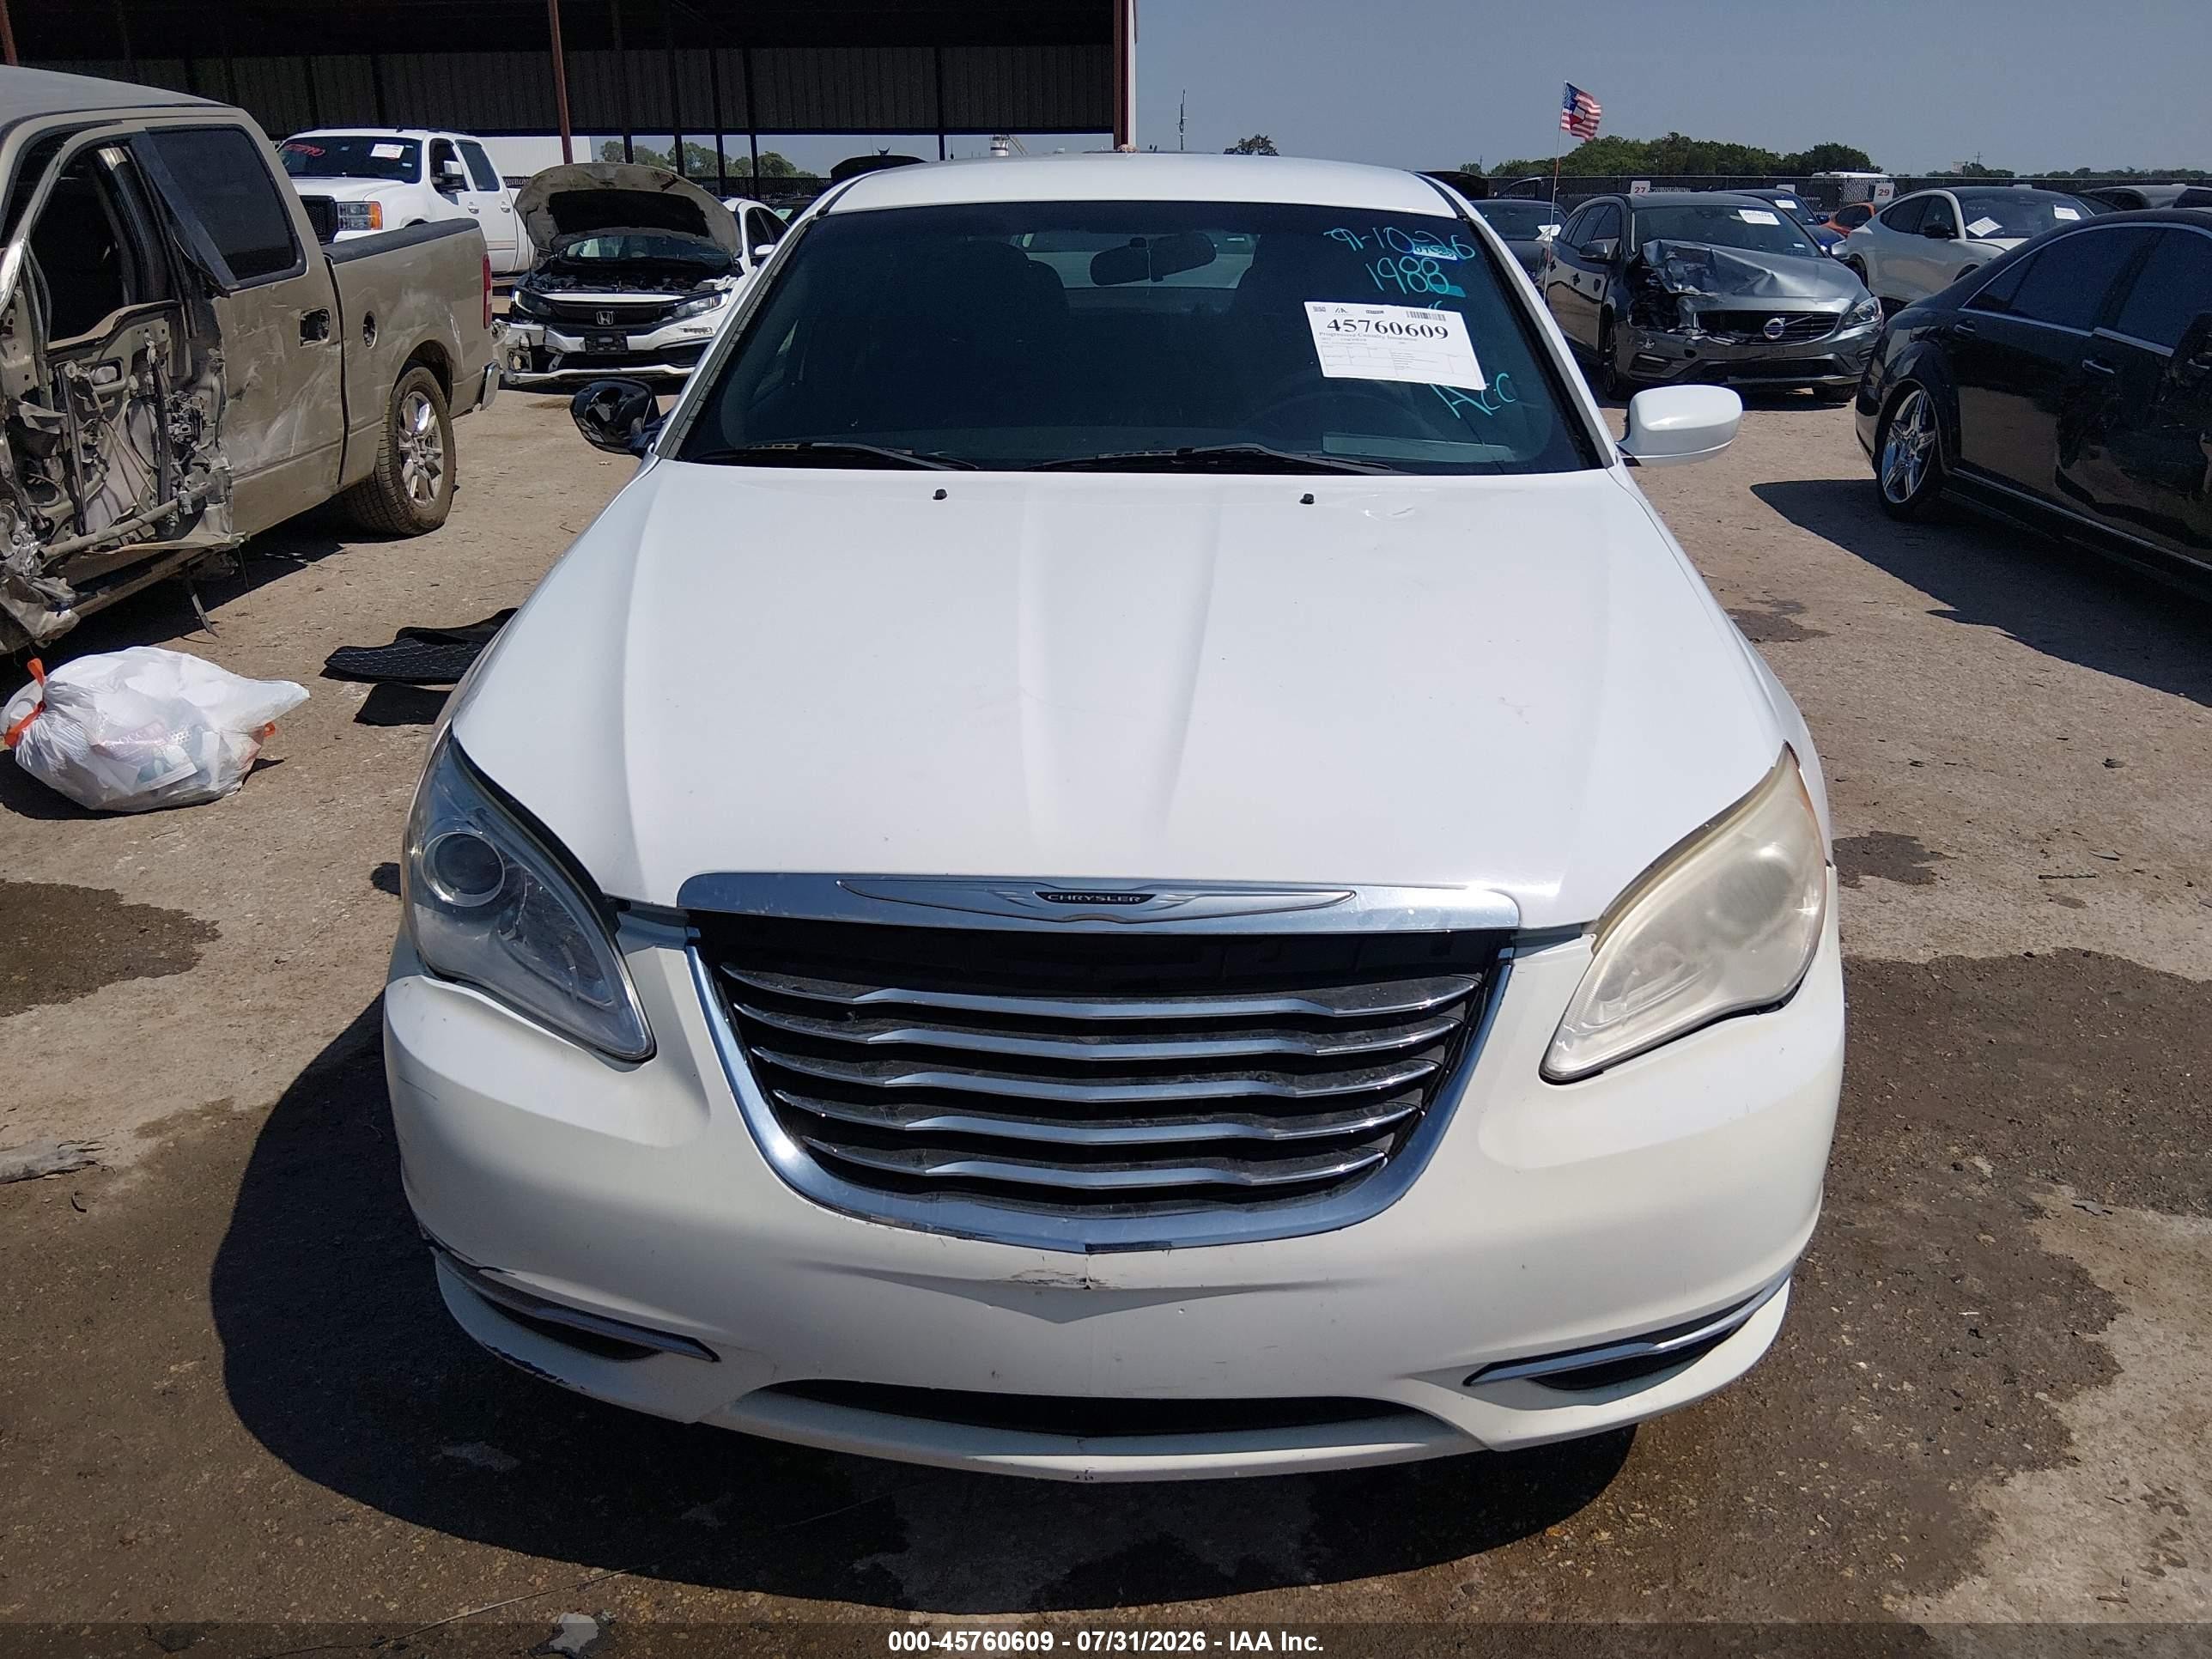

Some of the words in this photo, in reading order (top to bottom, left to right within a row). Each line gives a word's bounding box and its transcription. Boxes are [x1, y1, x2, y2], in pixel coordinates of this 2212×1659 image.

[1878, 188, 1890, 197] 29
[1365, 256, 1449, 295] 1988
[1327, 318, 1449, 340] 45760609
[1047, 894, 1141, 902] CHRYSLER
